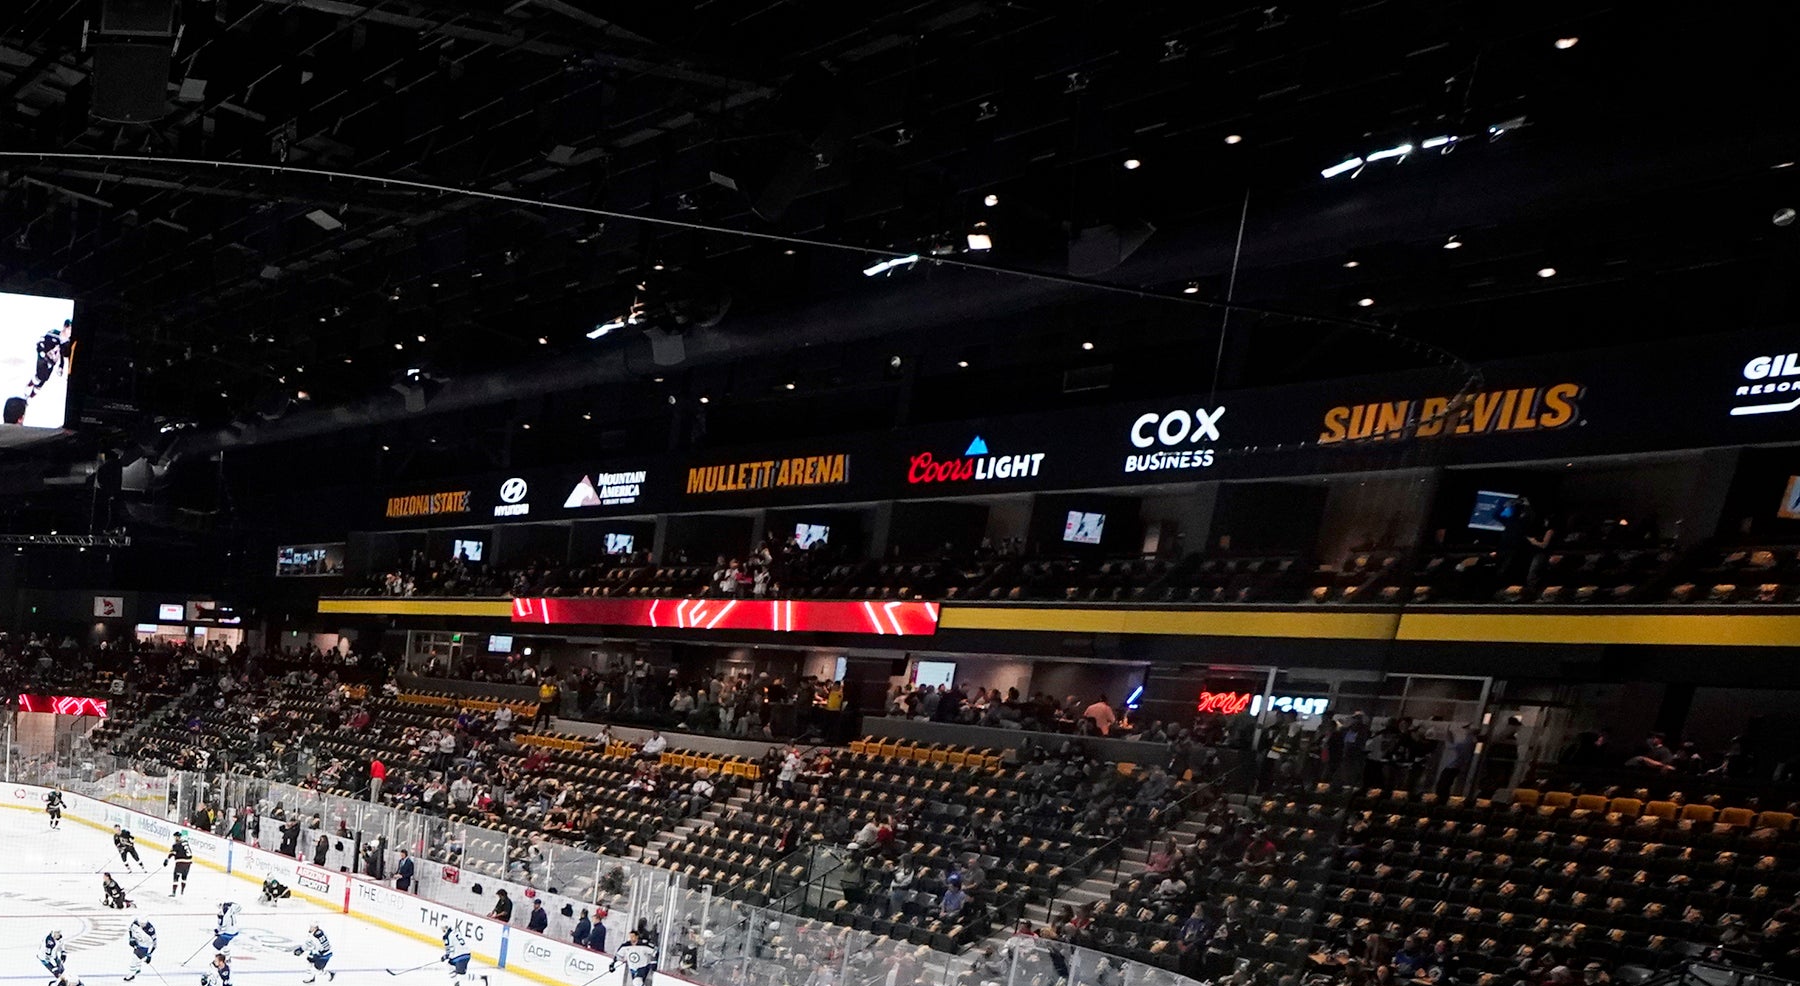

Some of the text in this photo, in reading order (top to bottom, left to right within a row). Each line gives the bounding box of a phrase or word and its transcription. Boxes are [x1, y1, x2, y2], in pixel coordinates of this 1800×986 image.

[1318, 383, 1581, 446] SUN DEVILS
[1130, 406, 1226, 449] COX
[686, 453, 846, 494] MULLETT ARENA
[907, 452, 1046, 485] Coors LIGHT
[1125, 449, 1215, 473] BUSINESS
[597, 471, 647, 487] MOUNTAIN
[386, 490, 467, 517] ARIZONA STATE
[600, 485, 640, 499] AMERICA
[494, 503, 529, 517] HYUNDAI
[454, 918, 485, 942] KEG
[456, 934, 466, 947] 5
[528, 944, 595, 972] ACP ACP
